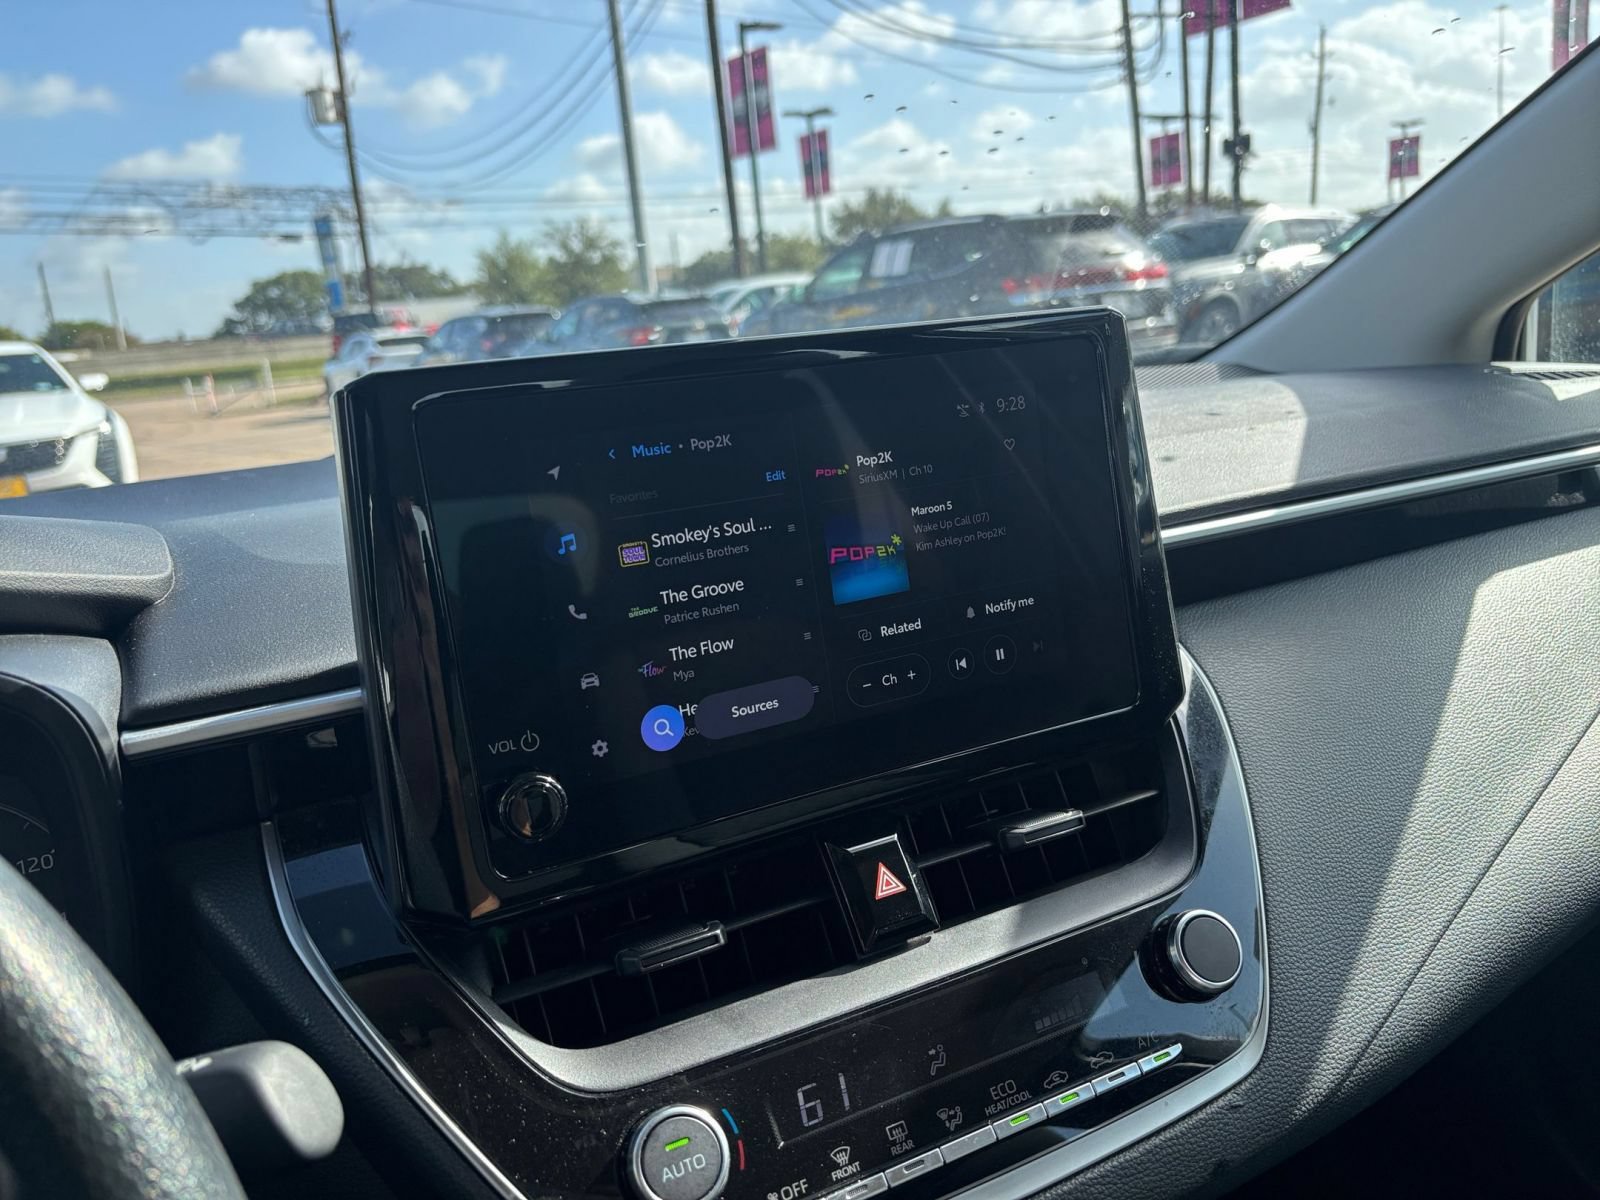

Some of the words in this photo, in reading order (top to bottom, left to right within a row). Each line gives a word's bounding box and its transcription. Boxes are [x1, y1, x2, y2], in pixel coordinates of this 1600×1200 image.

[996, 395, 1026, 413] 9:28
[631, 442, 672, 459] Music
[690, 434, 732, 452] Pop2K
[856, 451, 893, 468] Pop2K
[765, 469, 786, 482] Edit
[858, 469, 898, 485] SiriusXM
[909, 465, 922, 477] Ch
[923, 464, 933, 475] 10
[609, 488, 659, 504] Favorites
[911, 503, 946, 517] Maroon
[946, 501, 953, 511] 5
[651, 525, 721, 549] Smokey's
[723, 518, 756, 538] Soul
[913, 521, 938, 534] Wake
[940, 519, 953, 531] Up
[954, 515, 972, 527] Call
[972, 512, 990, 525] (07)
[915, 539, 933, 552] Kim
[934, 534, 963, 550] Ashley
[963, 533, 975, 543] on
[976, 527, 1007, 542] Pop2K!
[654, 551, 705, 568] Cornelius
[707, 543, 750, 559] Brothers
[660, 589, 688, 605] The
[691, 579, 745, 601] Groove
[663, 609, 700, 625] Patrice
[702, 602, 740, 618] Rushen
[985, 599, 1016, 616] Notify
[1018, 595, 1035, 607] me
[880, 618, 922, 638] Related
[669, 646, 697, 662] The
[700, 638, 735, 656] Flow
[672, 668, 695, 682] Mya
[881, 673, 898, 687] Ch
[731, 699, 779, 718] Sources
[488, 739, 517, 755] VOL
[16, 853, 54, 875] 120
[1137, 1030, 1160, 1049] A/C
[797, 1072, 850, 1127] 61
[990, 1079, 1017, 1100] ECO
[984, 1090, 1032, 1117] HEAT/COOL
[890, 1139, 915, 1156] REAR
[661, 1153, 706, 1183] AUTO
[831, 1161, 861, 1181] FRONT
[780, 1178, 809, 1200] OFF
